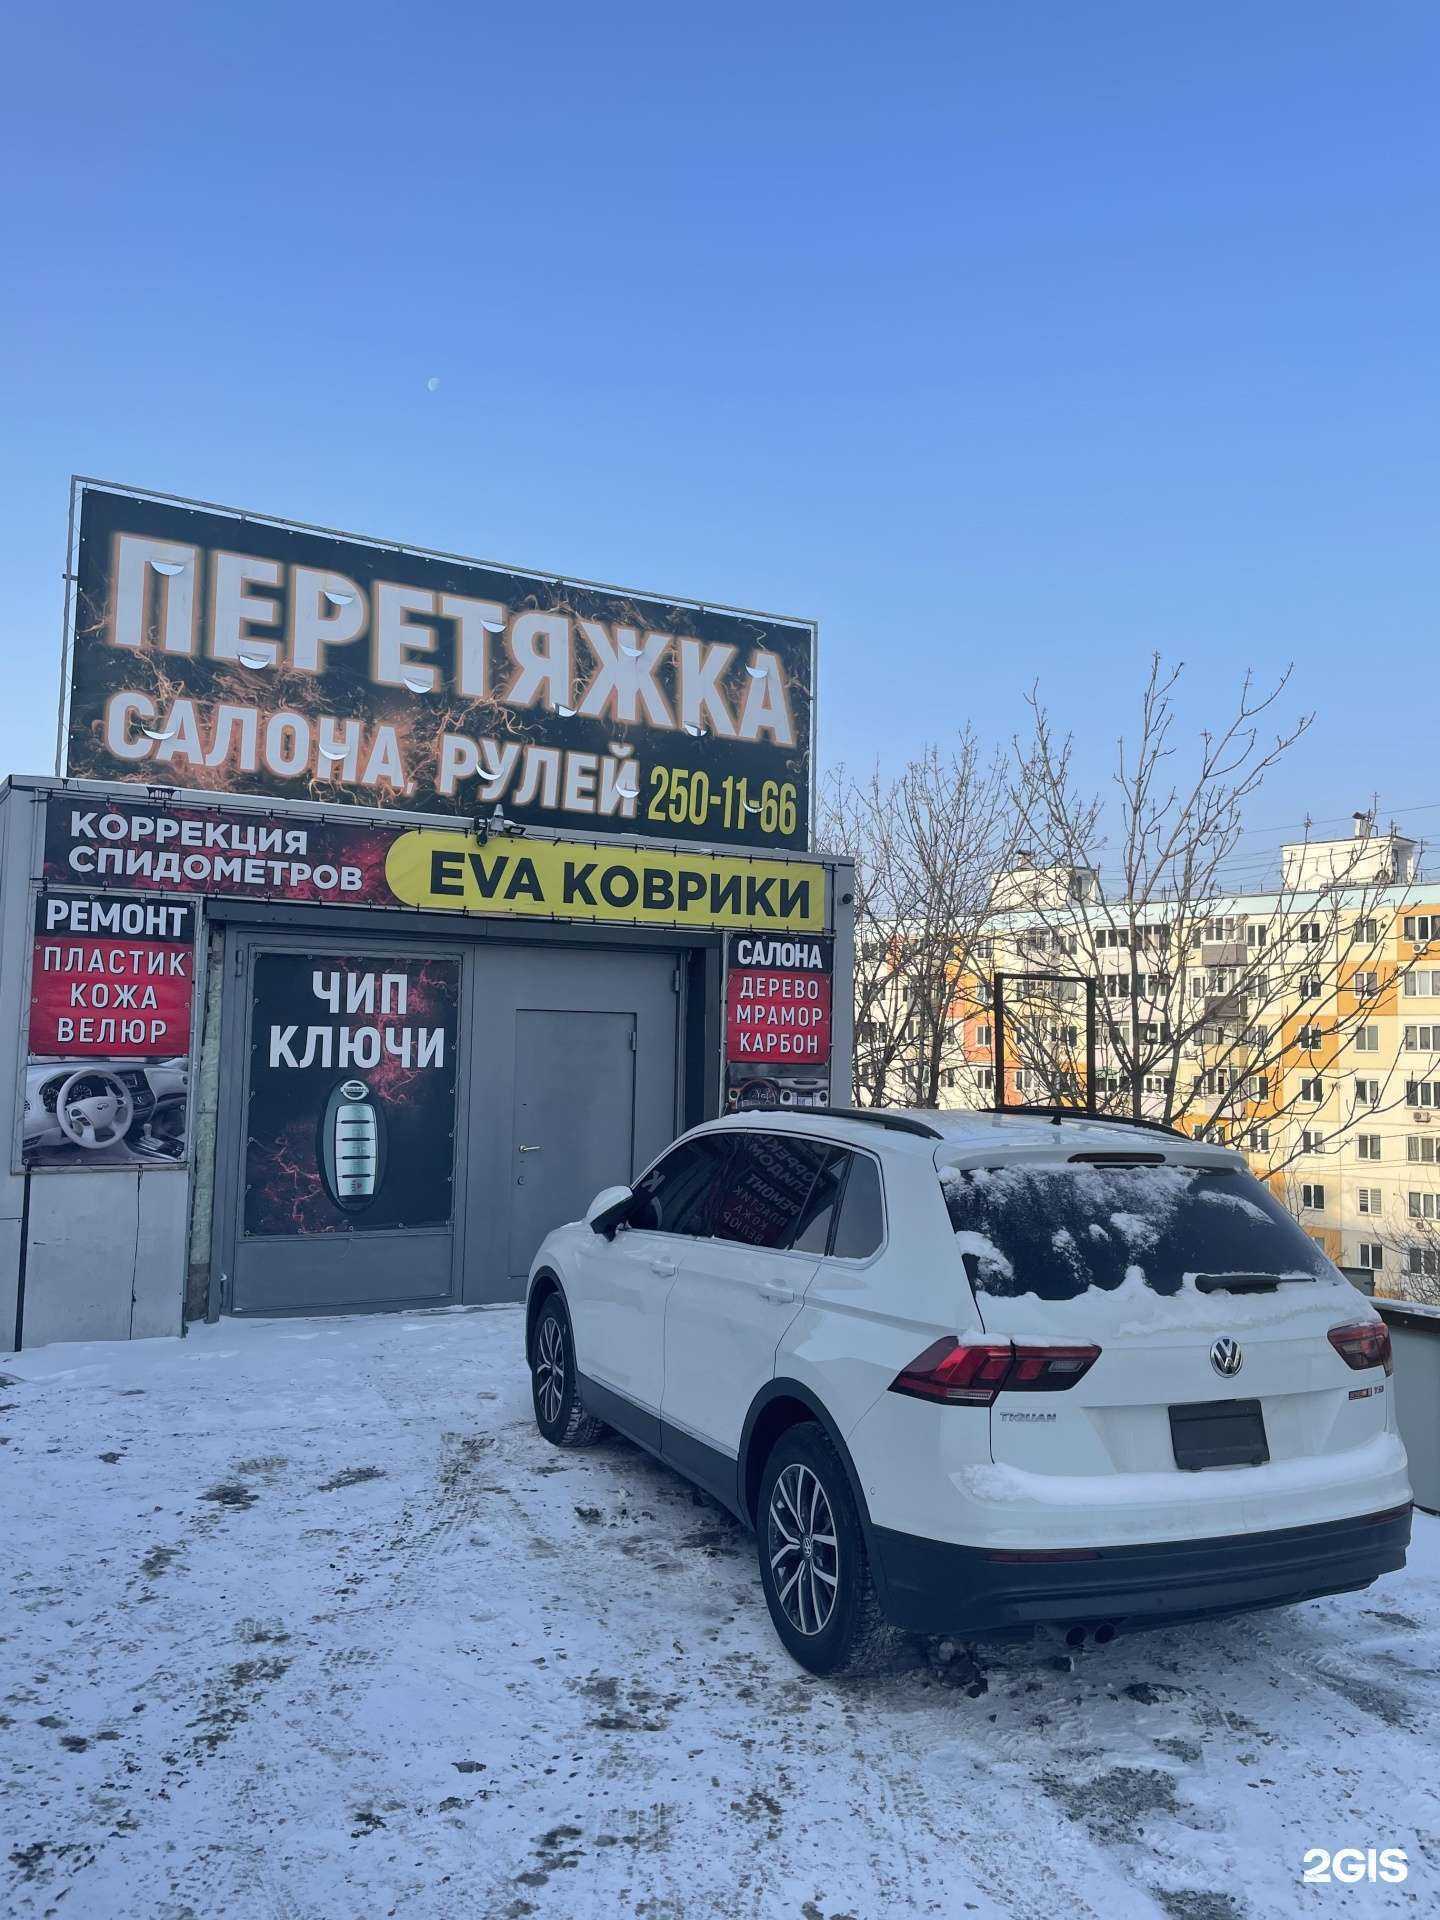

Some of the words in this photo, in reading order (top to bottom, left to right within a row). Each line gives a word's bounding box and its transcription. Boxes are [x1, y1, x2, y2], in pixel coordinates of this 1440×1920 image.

[113, 535, 794, 745] ПЕРЕТЯЖКА
[438, 733, 640, 817] РУЛЕЙ
[648, 766, 797, 834] 250-11-66
[71, 811, 308, 856] КОРРЕКЦИЯ
[68, 845, 364, 891] СПИДОМЕТРОВ
[430, 850, 544, 902] EVA
[563, 861, 810, 918] КОВРИКИ
[46, 899, 188, 937] РЕМОНТ
[43, 946, 186, 977] ПЛАСТИК
[737, 939, 823, 969] САЛОНА
[70, 982, 158, 1010] КОЖА
[312, 970, 408, 1015] ЧИП
[740, 977, 819, 1000] ДЕРЕВО
[57, 1018, 168, 1044] ВЕЛЮР
[736, 1004, 823, 1027] МРАМОР
[269, 1024, 446, 1069] КЛЮЧИ
[740, 1032, 818, 1054] КАРБОН
